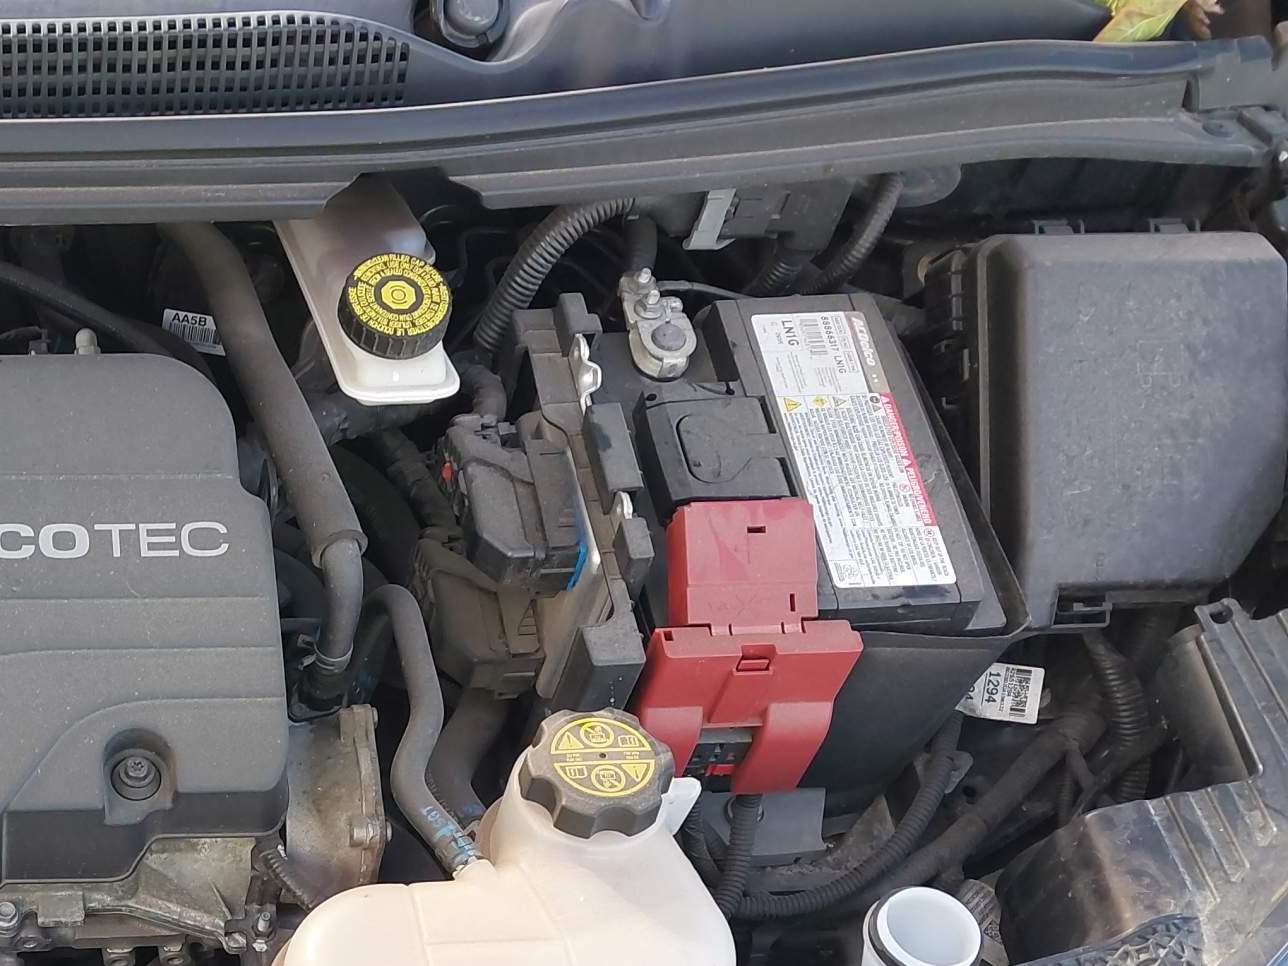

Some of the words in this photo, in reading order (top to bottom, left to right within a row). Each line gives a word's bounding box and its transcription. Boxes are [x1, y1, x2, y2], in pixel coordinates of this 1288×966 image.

[172, 313, 207, 326] AA5B
[782, 320, 800, 346] LN1G
[985, 671, 1002, 704] 1294
